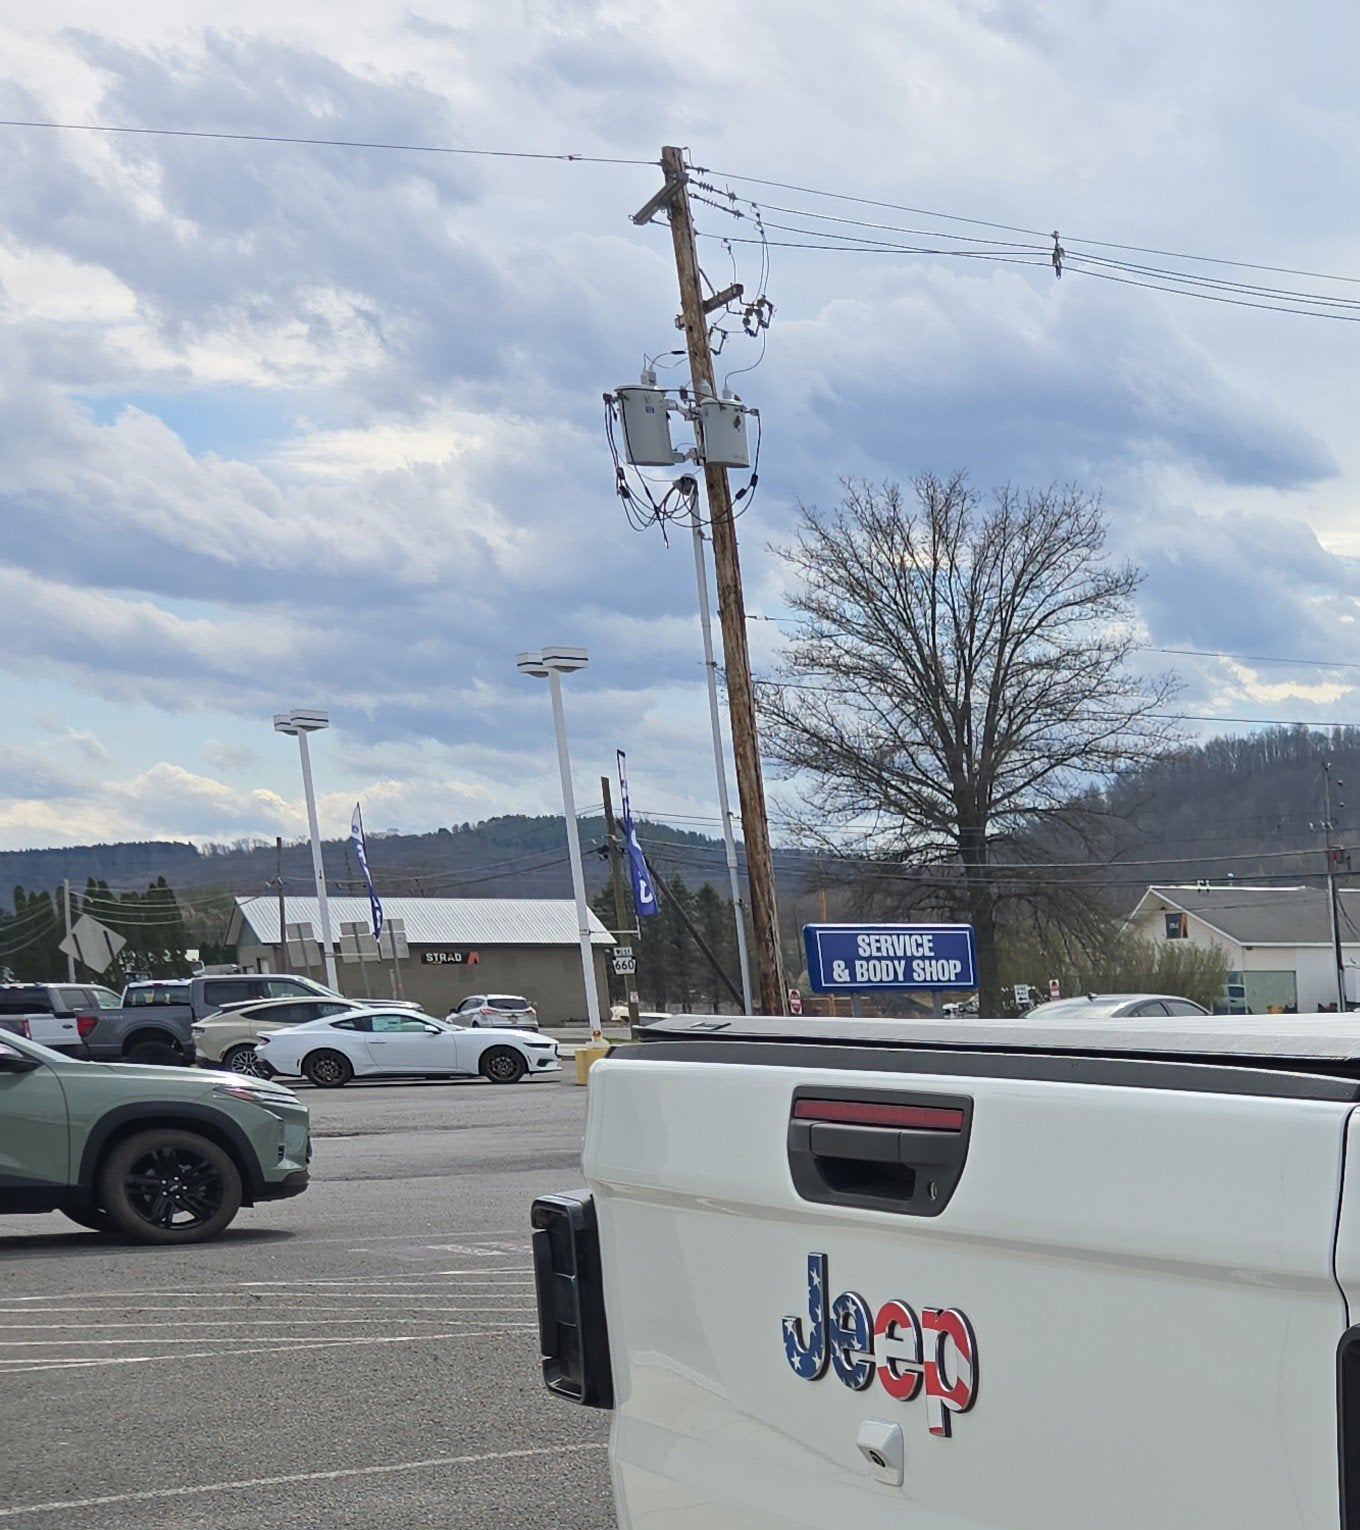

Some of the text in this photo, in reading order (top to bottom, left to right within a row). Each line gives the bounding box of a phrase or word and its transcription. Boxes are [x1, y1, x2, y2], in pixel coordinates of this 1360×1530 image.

[426, 952, 462, 962] STRAD
[857, 934, 934, 957] SERVICE
[615, 960, 635, 971] 660
[832, 959, 962, 983] & BODY SHOP
[782, 1251, 979, 1438] Jeep
